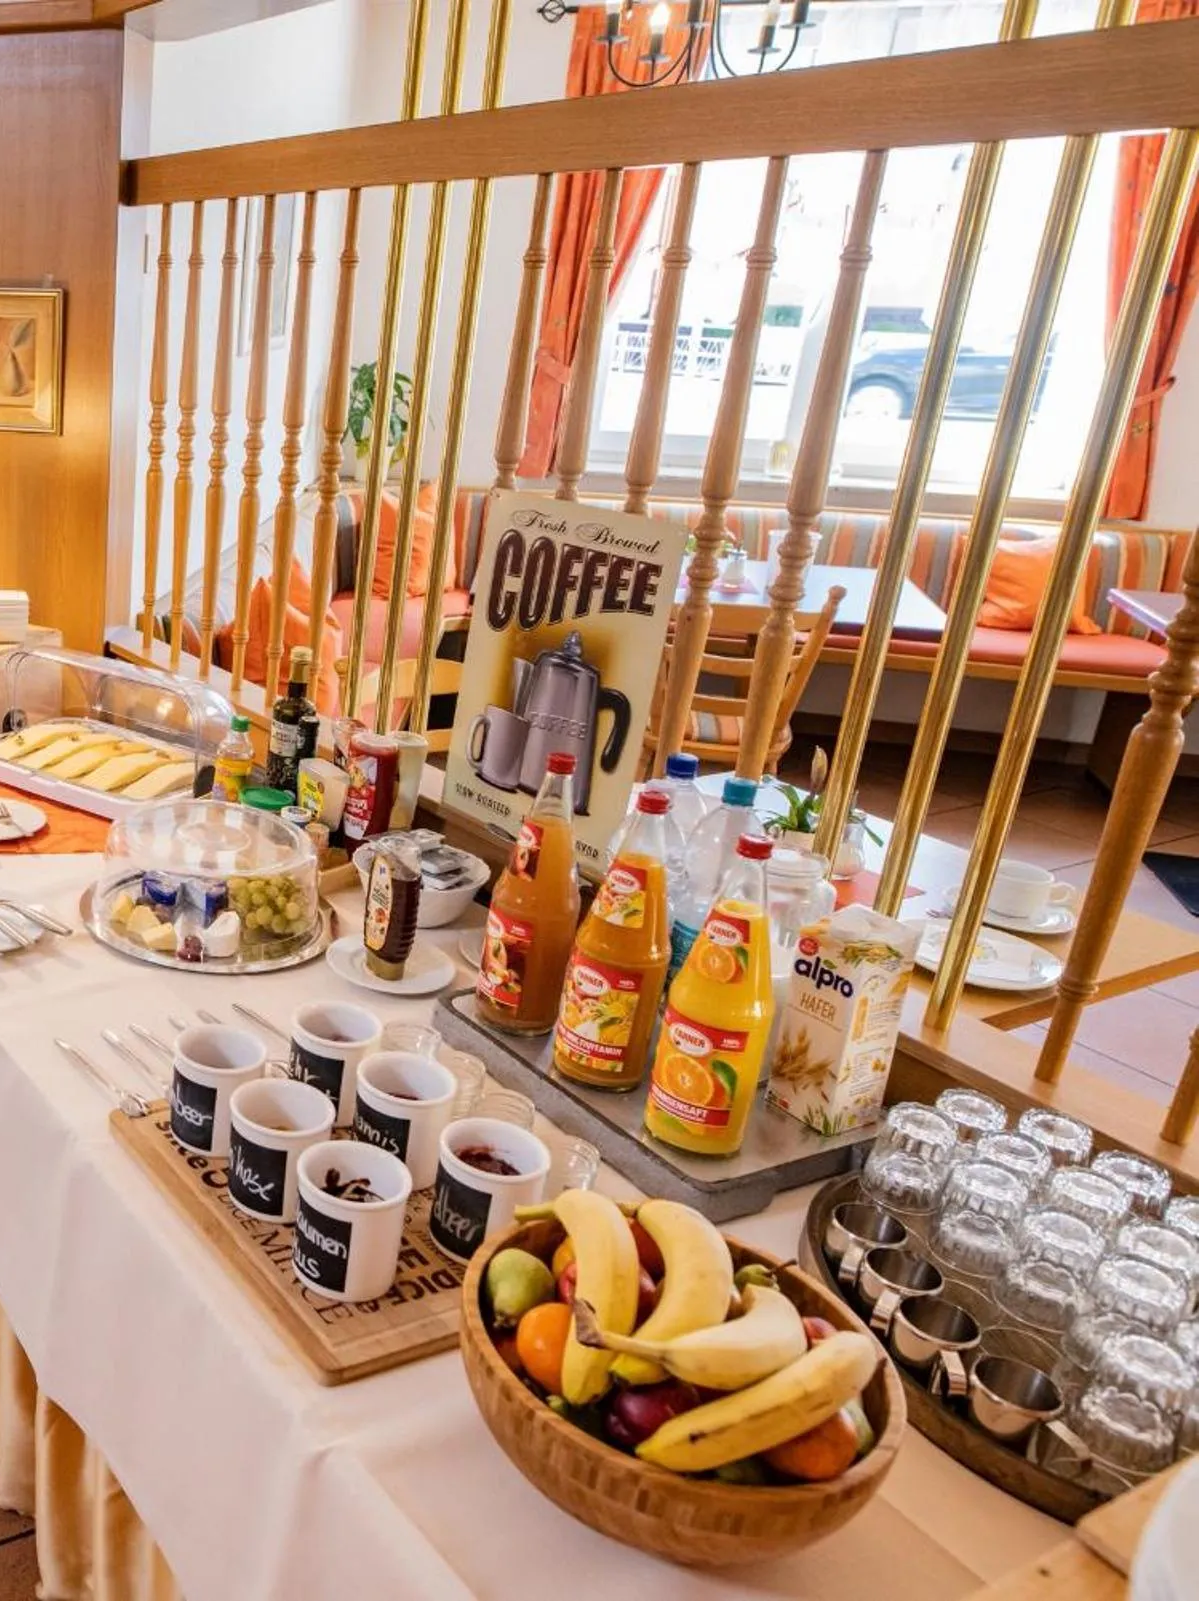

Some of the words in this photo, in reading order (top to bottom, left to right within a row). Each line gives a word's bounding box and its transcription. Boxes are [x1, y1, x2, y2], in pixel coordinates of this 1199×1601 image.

[511, 509, 568, 536] Fresh
[575, 522, 662, 554] Brewed
[486, 528, 664, 632] COFFEE
[793, 955, 855, 999] alpro
[800, 992, 837, 1022] HAFER
